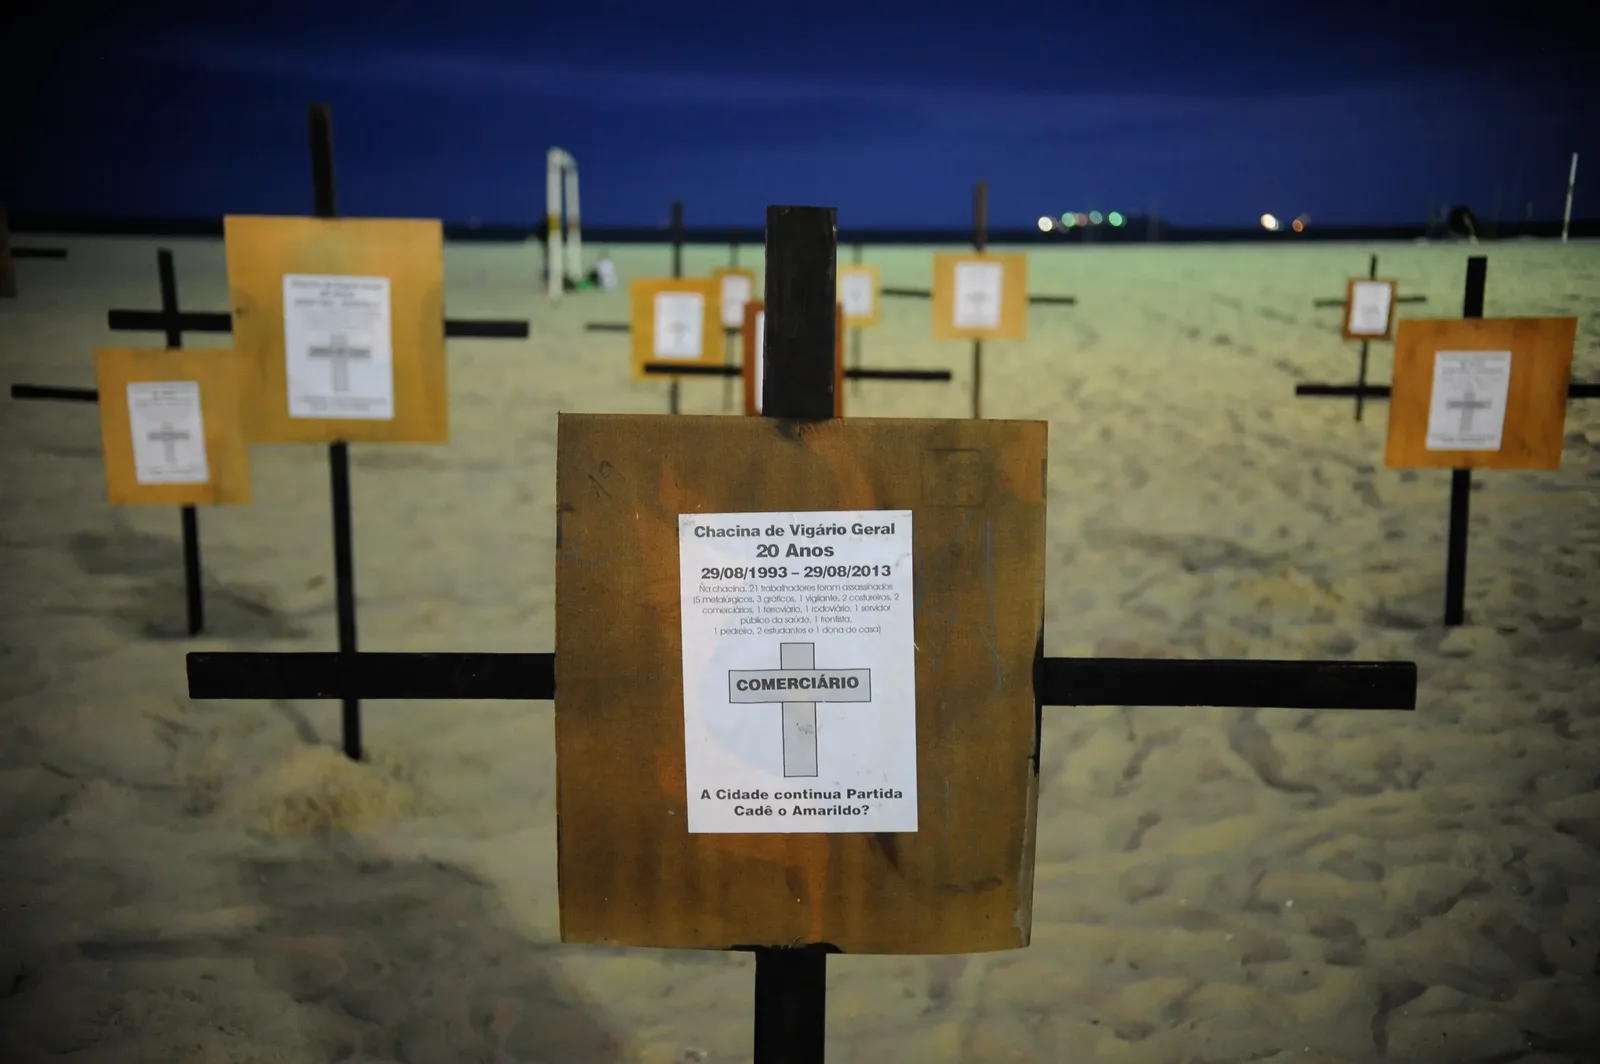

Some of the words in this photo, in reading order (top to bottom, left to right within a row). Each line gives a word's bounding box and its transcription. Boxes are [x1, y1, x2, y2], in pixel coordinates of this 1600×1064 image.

[694, 525, 761, 538] Chacina
[765, 524, 785, 537] de
[789, 523, 847, 538] Vigário
[851, 522, 896, 536] Geral
[756, 544, 779, 558] 20
[785, 543, 835, 557] Anos
[701, 566, 788, 580] 29/08/1993
[803, 564, 892, 578] 29/08/2013
[712, 584, 747, 593] chacina,
[749, 584, 758, 592] 21
[760, 584, 816, 592] trabalhadores
[816, 583, 841, 591] foram
[842, 583, 893, 591] assassinados
[692, 596, 701, 604] (5
[757, 595, 762, 603] 3
[861, 604, 891, 612] servidor
[740, 617, 770, 625] público
[771, 616, 783, 624] da
[763, 626, 807, 634] estudantes
[858, 625, 882, 634] casa)
[736, 674, 859, 691] COMERCIÁRIO
[700, 789, 711, 800] A
[715, 789, 769, 800] Cidade
[774, 789, 841, 800] continua
[846, 788, 903, 799] Partida
[734, 805, 773, 817] Cadê
[778, 807, 787, 816] o
[792, 805, 870, 816] Amarildo?
